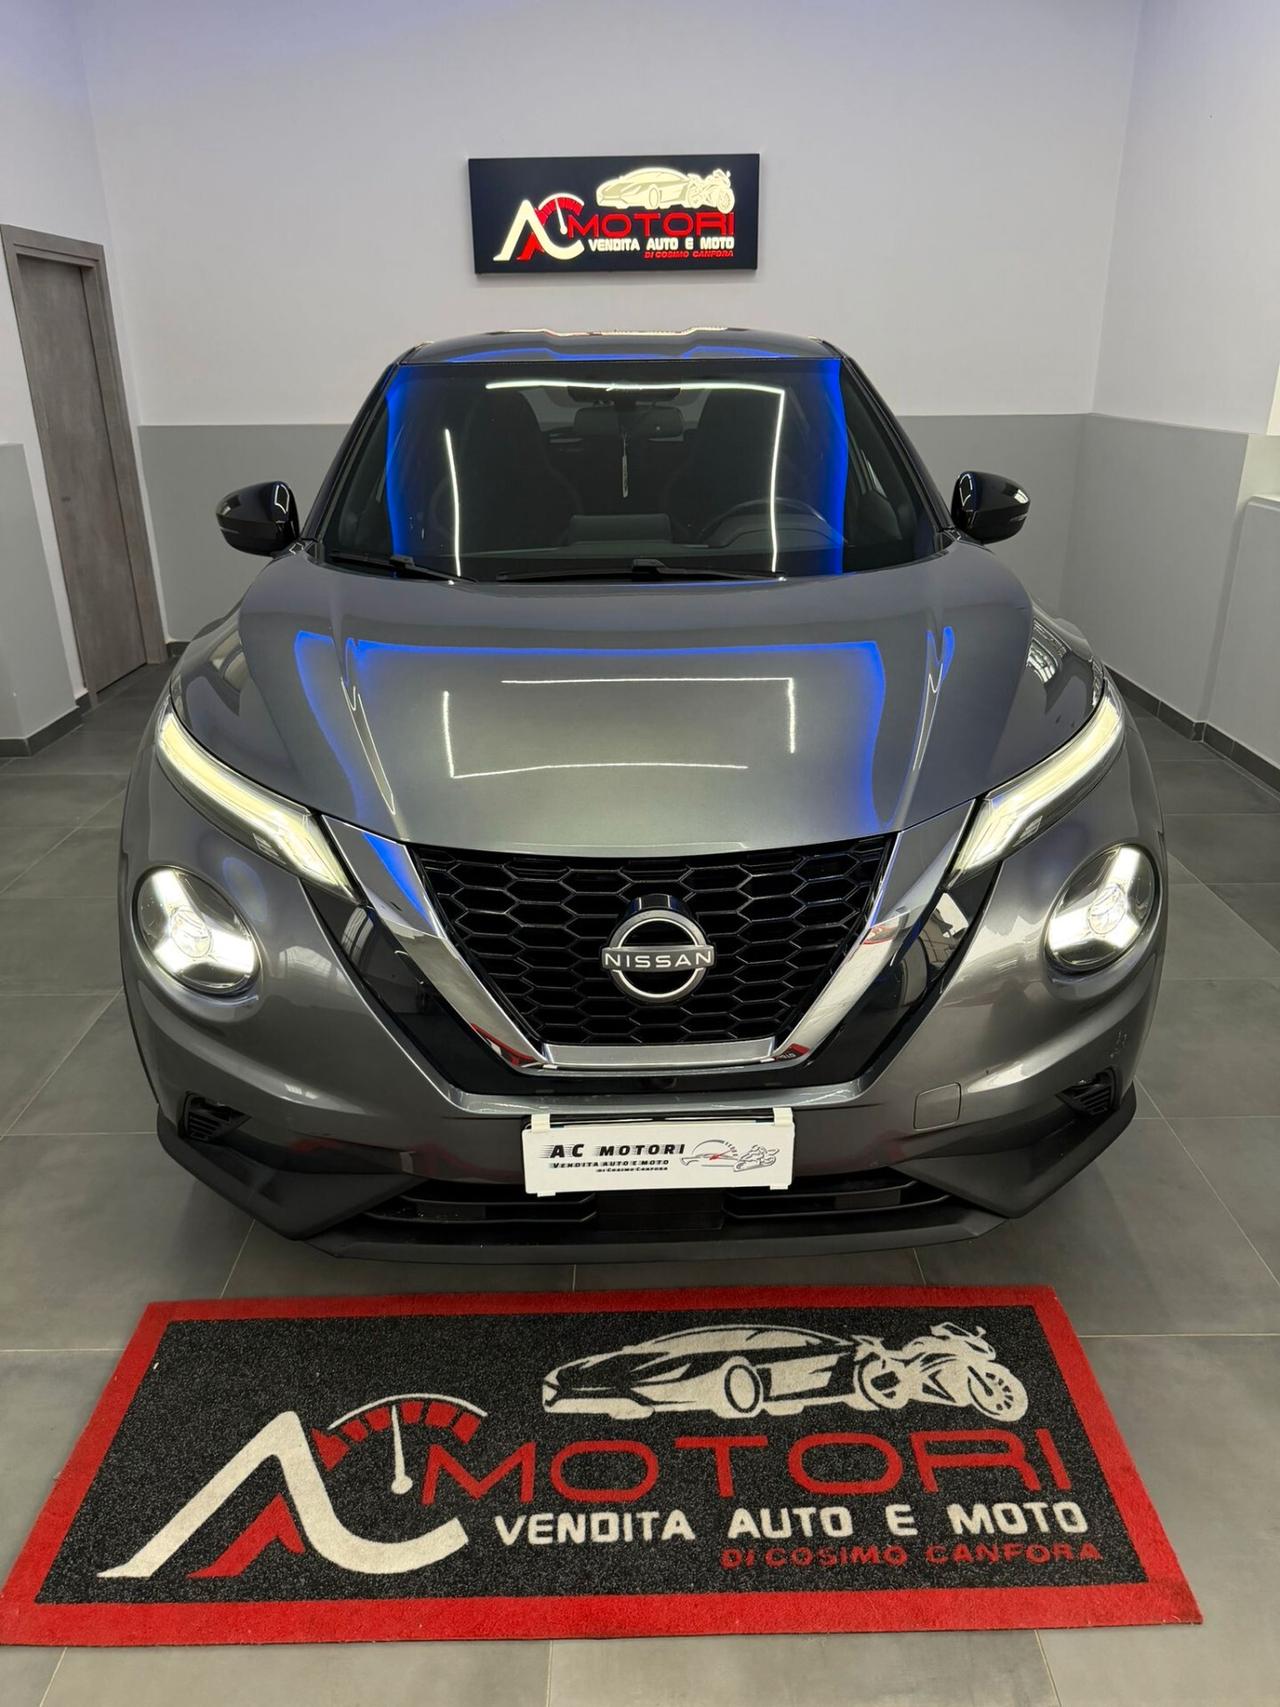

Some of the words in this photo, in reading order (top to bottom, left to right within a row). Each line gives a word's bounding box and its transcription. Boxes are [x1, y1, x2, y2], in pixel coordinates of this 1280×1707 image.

[567, 212, 735, 238] MOTORI
[588, 238, 640, 252] VENDITA
[646, 237, 679, 250] AUTO
[685, 237, 694, 250] E
[700, 236, 735, 249] MOTO
[644, 251, 654, 259] DI
[692, 250, 734, 258] CANFORA
[604, 950, 713, 968] NISSAN
[550, 1143, 584, 1158] AC
[600, 1143, 685, 1156] MOTORI
[422, 1428, 1072, 1504] MOTORI
[494, 1509, 696, 1546] VENDITA
[727, 1506, 854, 1540] AUTO
[885, 1503, 919, 1537] E
[947, 1501, 1089, 1535] MOTO
[720, 1546, 755, 1569] DI
[763, 1543, 909, 1568] COSIMO
[924, 1541, 1104, 1564] CANFORA
